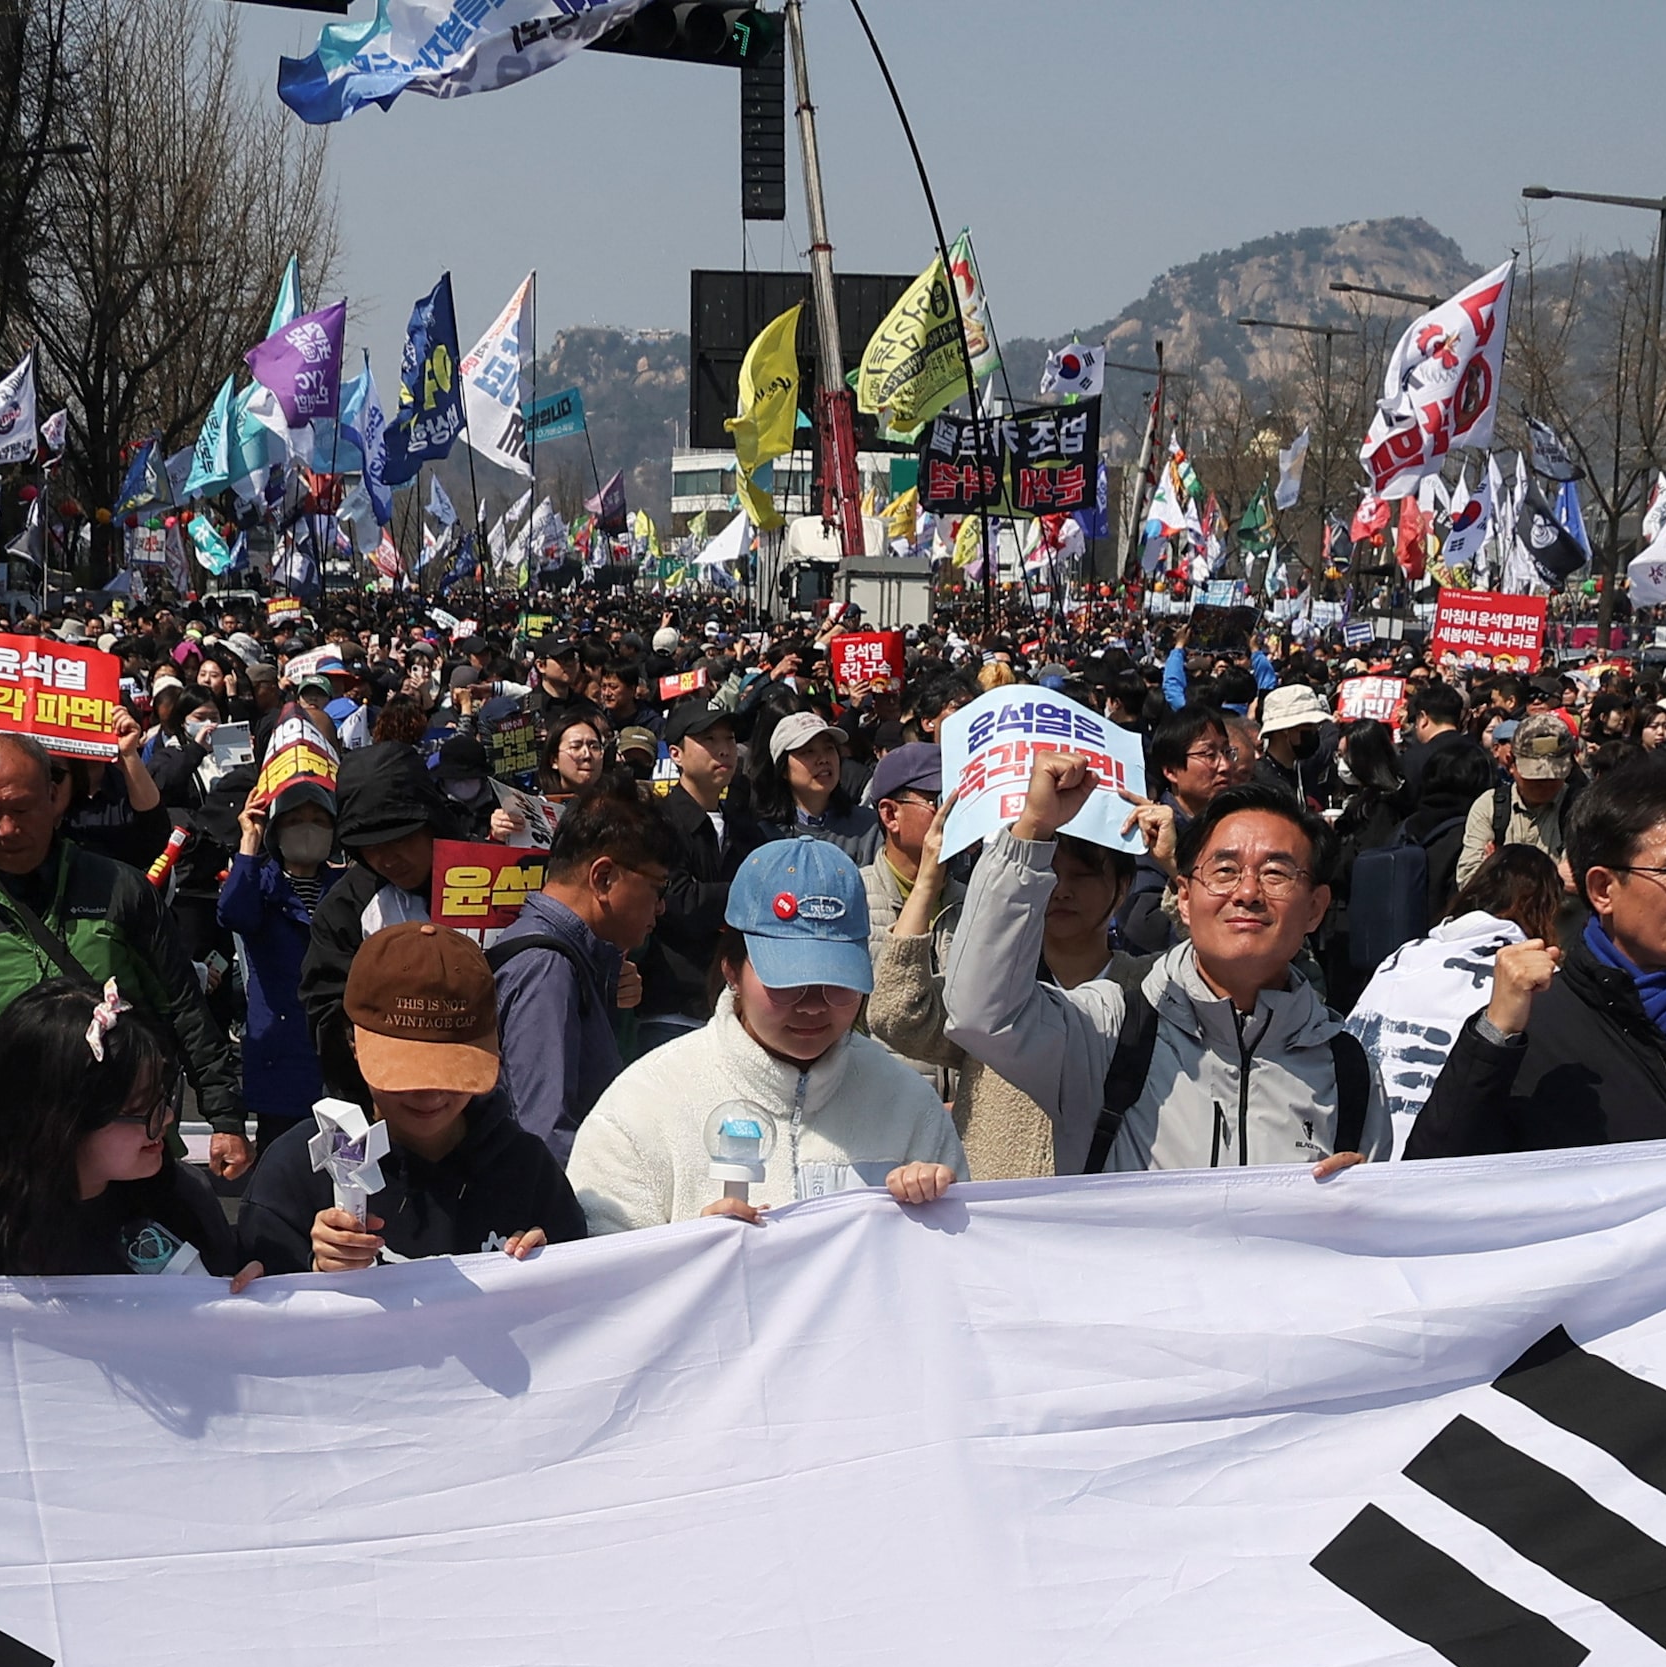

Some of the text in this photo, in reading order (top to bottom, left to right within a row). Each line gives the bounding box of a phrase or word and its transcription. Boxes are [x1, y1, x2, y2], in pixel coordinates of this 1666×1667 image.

[1439, 608, 1540, 632] 마침내 윤석열 파면
[1437, 626, 1538, 650] 새봄에는 새나라로
[844, 641, 884, 662] 윤석열
[839, 660, 892, 680] 즉각 구속
[34, 692, 115, 735] 파면!
[968, 702, 1106, 755] 윤석열은
[809, 901, 835, 914] retro
[395, 996, 467, 1012] THIS IS NOT
[454, 1015, 478, 1030] CAP
